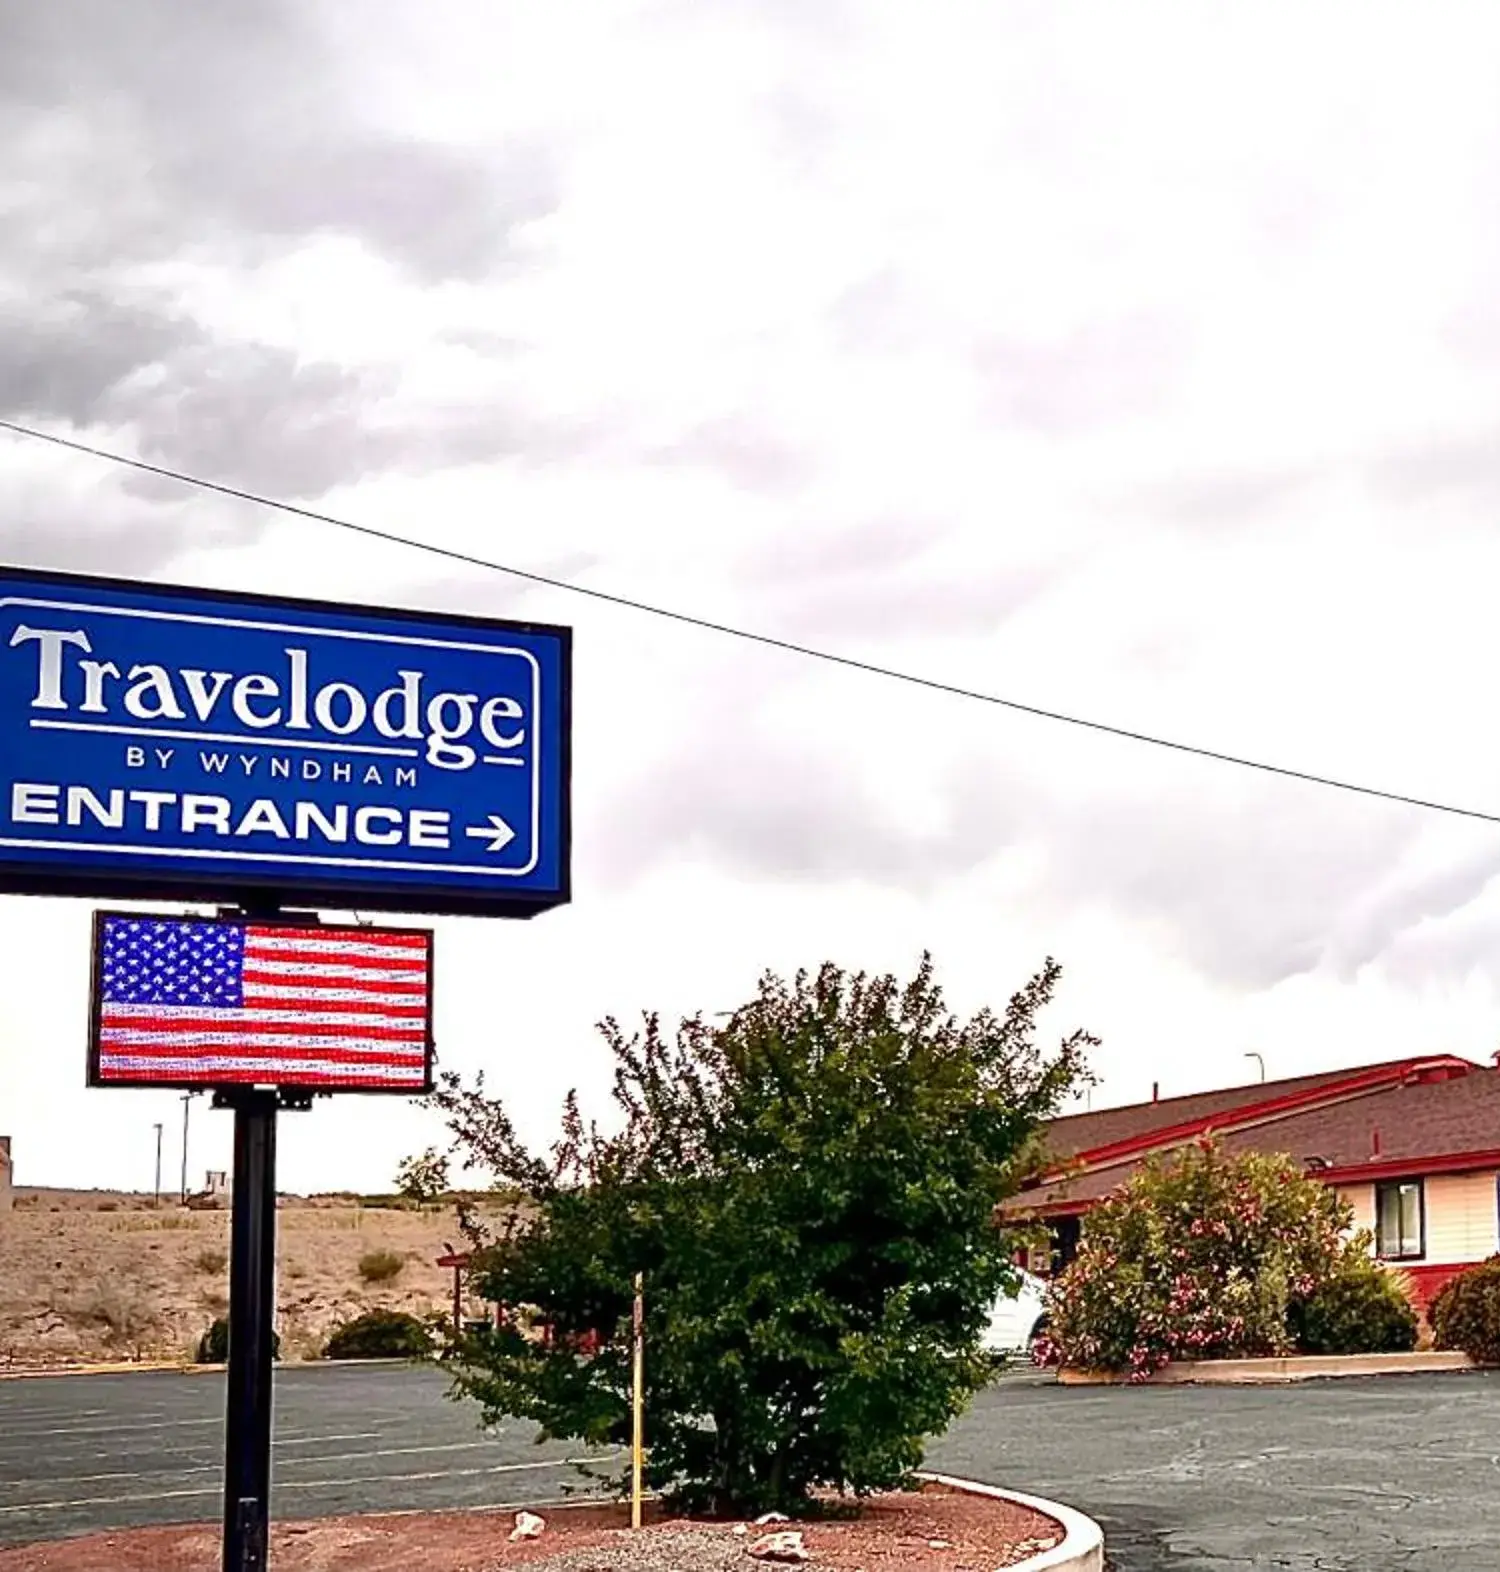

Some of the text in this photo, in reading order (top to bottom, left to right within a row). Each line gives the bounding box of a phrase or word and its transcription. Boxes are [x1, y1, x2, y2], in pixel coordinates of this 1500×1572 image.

[10, 623, 524, 770] Travelodge
[127, 746, 417, 787] BY WYNDHAM
[11, 783, 450, 849] ENTRANCE
